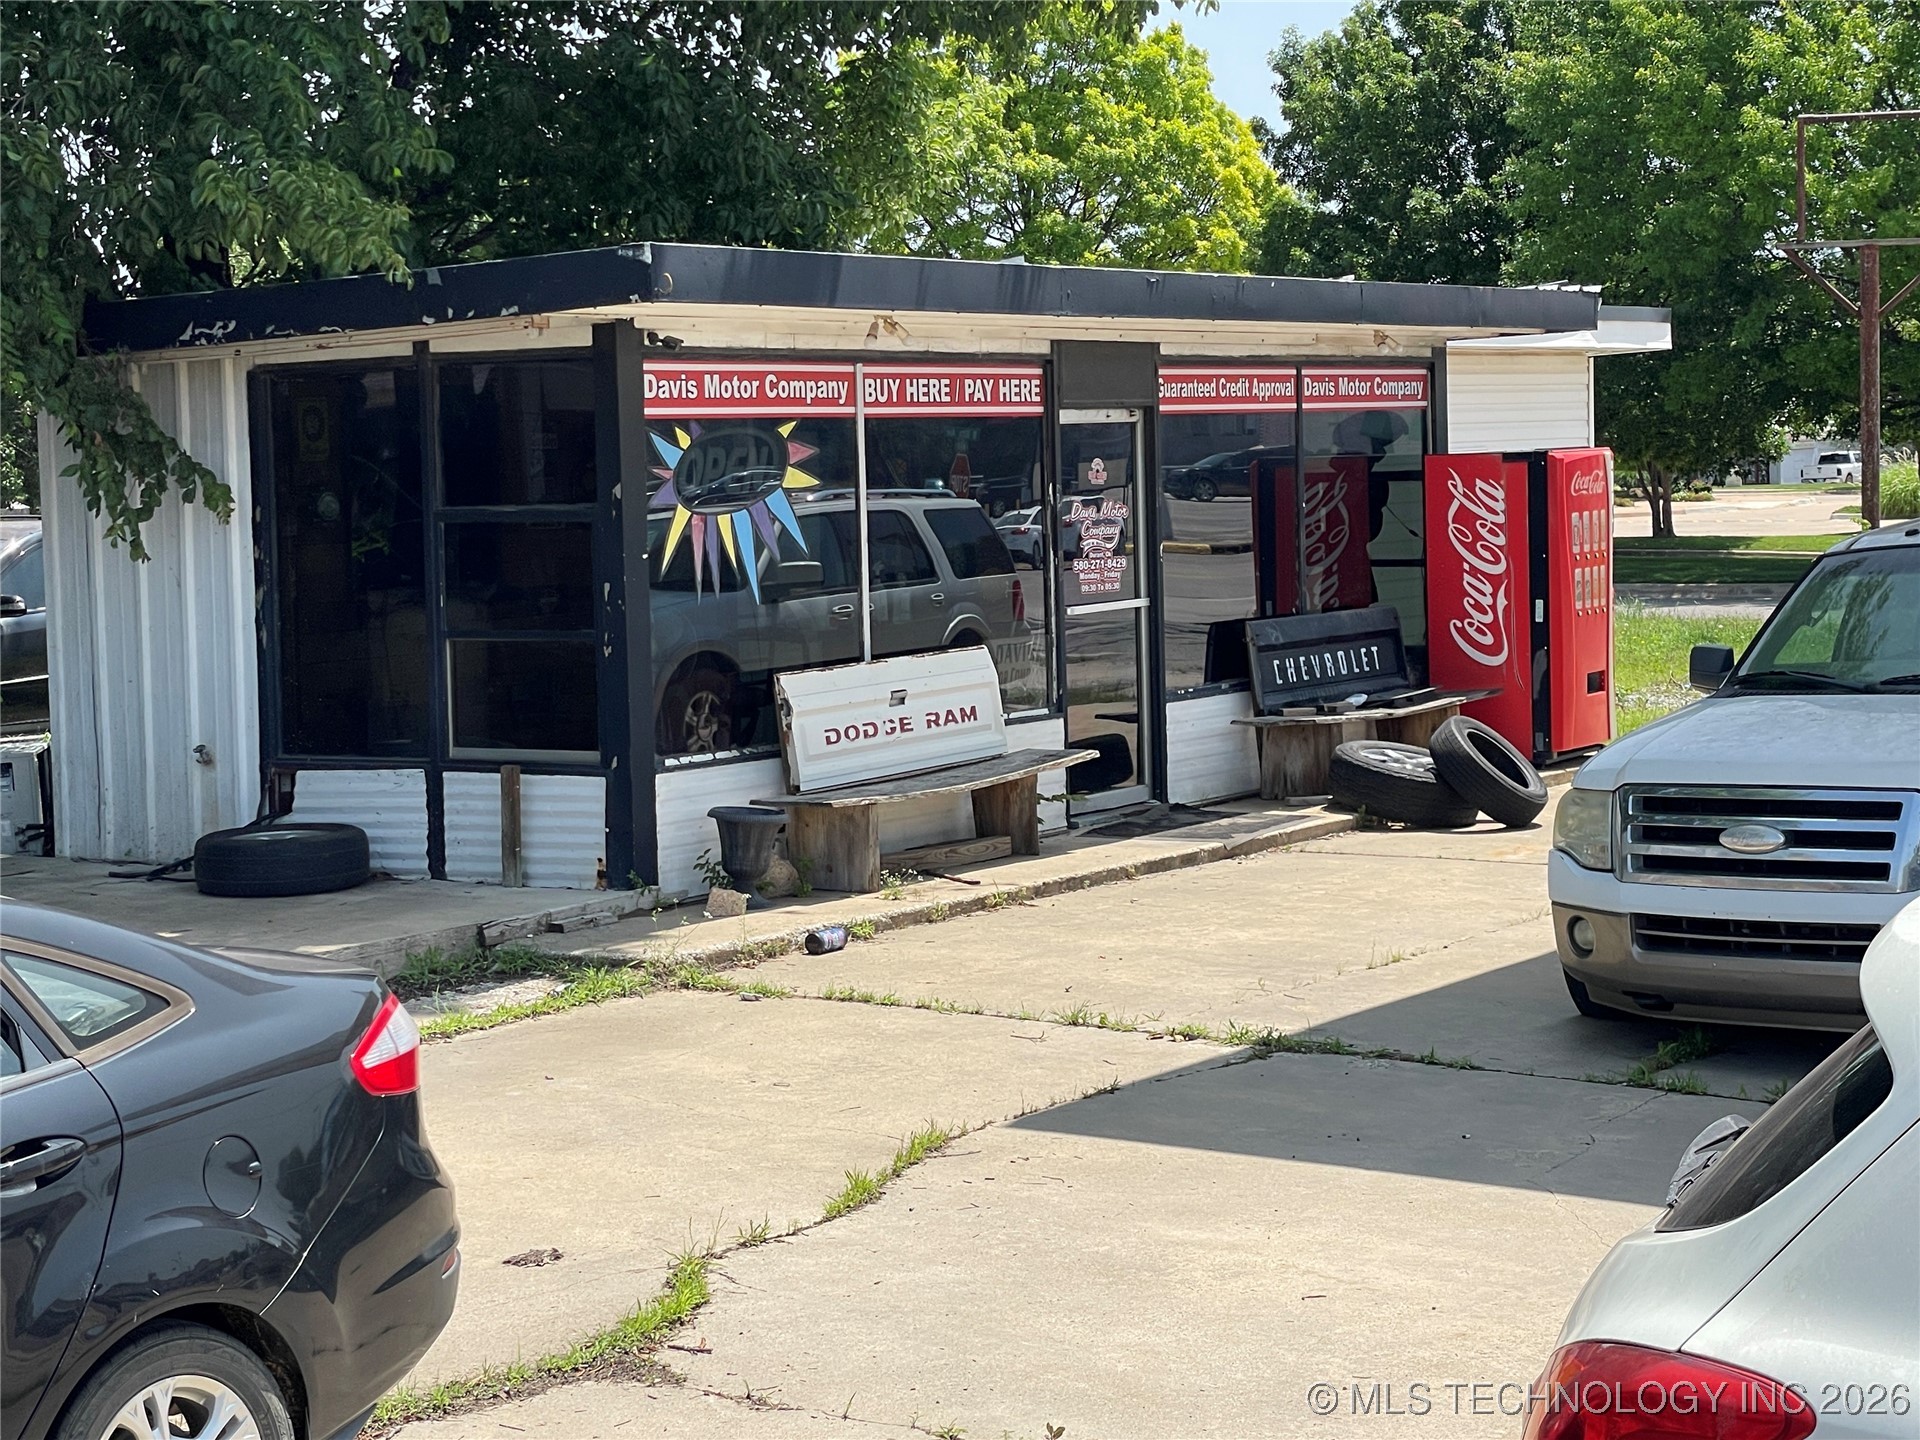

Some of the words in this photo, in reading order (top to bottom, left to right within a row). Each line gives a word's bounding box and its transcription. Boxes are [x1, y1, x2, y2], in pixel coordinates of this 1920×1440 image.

[643, 373, 697, 399] Davis
[705, 374, 760, 399] Motor
[764, 374, 849, 405] Company
[864, 378, 901, 403] BUY
[905, 378, 950, 403] HERE
[964, 378, 995, 403] PAY
[998, 378, 1042, 402] HERE
[1158, 378, 1217, 398] Guaranteed
[1219, 377, 1250, 397] Credit
[1252, 377, 1295, 401] Approval
[1304, 377, 1336, 397] Davis
[1338, 377, 1372, 396] Motor
[1374, 377, 1423, 400] Company
[680, 440, 771, 494] OPEN
[1071, 502, 1097, 520] Davis
[1100, 501, 1129, 519] Motor
[1081, 520, 1121, 538] Company
[1073, 558, 1127, 571] 580-271-8429
[1079, 572, 1100, 580] Monday
[1104, 571, 1120, 579] Friday
[1448, 467, 1509, 667] Coca-Cola
[1273, 646, 1382, 685] CHEVROLET
[925, 705, 979, 730] RAM
